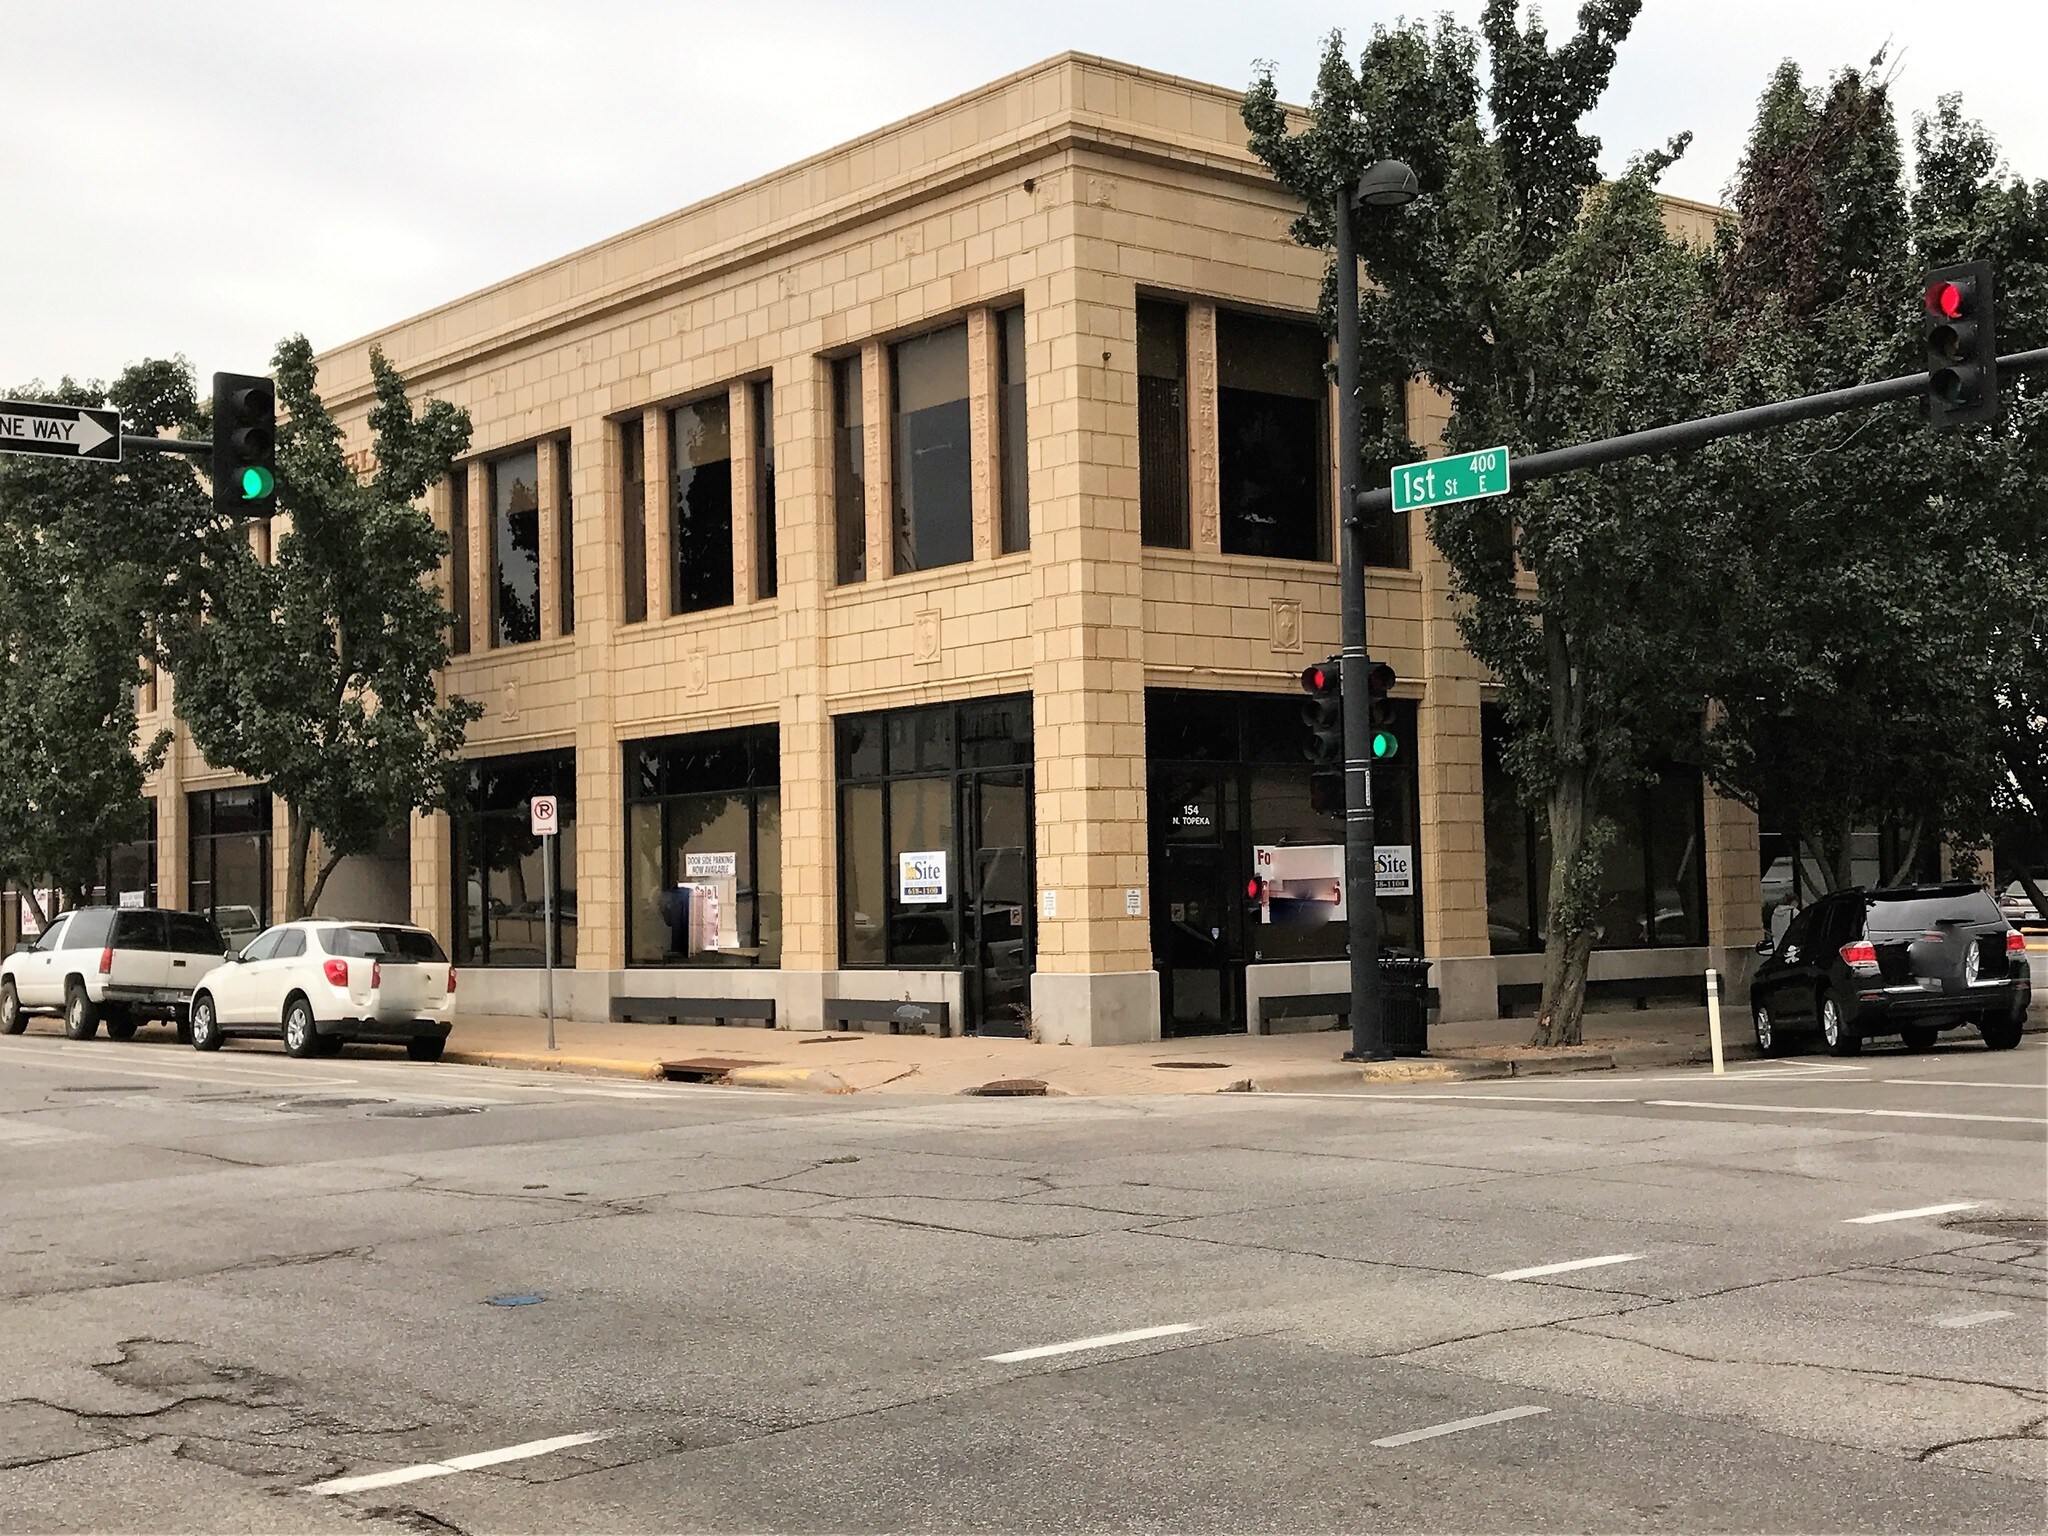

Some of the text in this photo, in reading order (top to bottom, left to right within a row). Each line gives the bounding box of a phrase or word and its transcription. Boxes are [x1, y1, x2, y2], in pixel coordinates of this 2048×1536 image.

[0, 416, 75, 440] NE WAY
[1469, 453, 1496, 473] 400
[1403, 468, 1487, 503] 1st St E
[1183, 804, 1200, 815] 154
[1172, 816, 1210, 825] N. TOPEKA
[688, 855, 733, 865] DOOR SIDE PARKING
[1257, 850, 1273, 865] Fo
[1374, 854, 1407, 873] Site
[692, 864, 729, 874] NOW AVAILABLE
[1374, 880, 1405, 888] 18-1100
